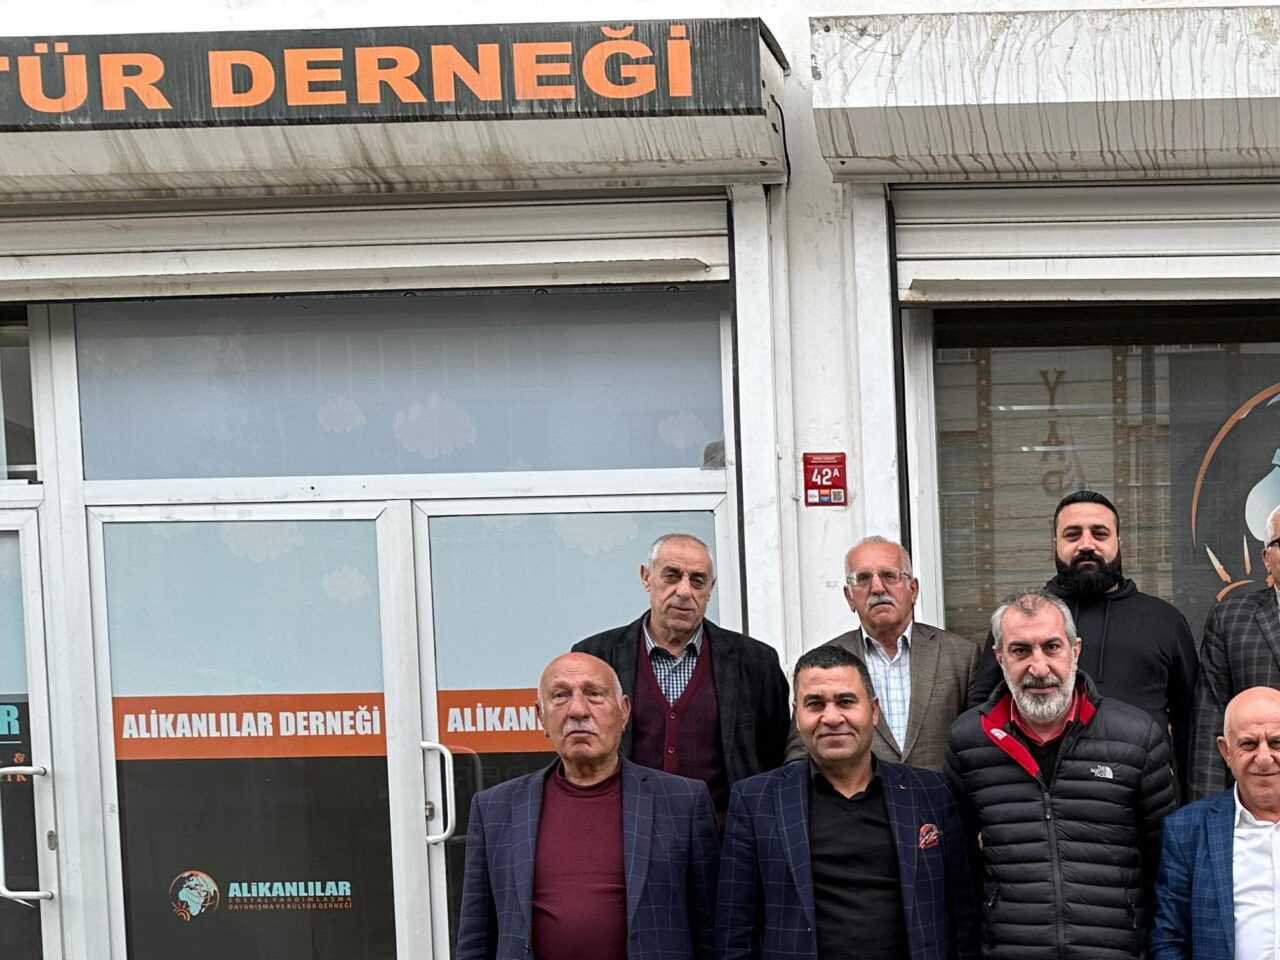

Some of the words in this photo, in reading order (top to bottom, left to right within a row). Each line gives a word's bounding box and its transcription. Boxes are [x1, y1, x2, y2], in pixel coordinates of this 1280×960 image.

[0, 42, 173, 113] ÜR
[207, 24, 693, 108] DERNEĞİ
[122, 709, 273, 739] ALİKANLILAR
[279, 705, 381, 736] DERNEĞİ
